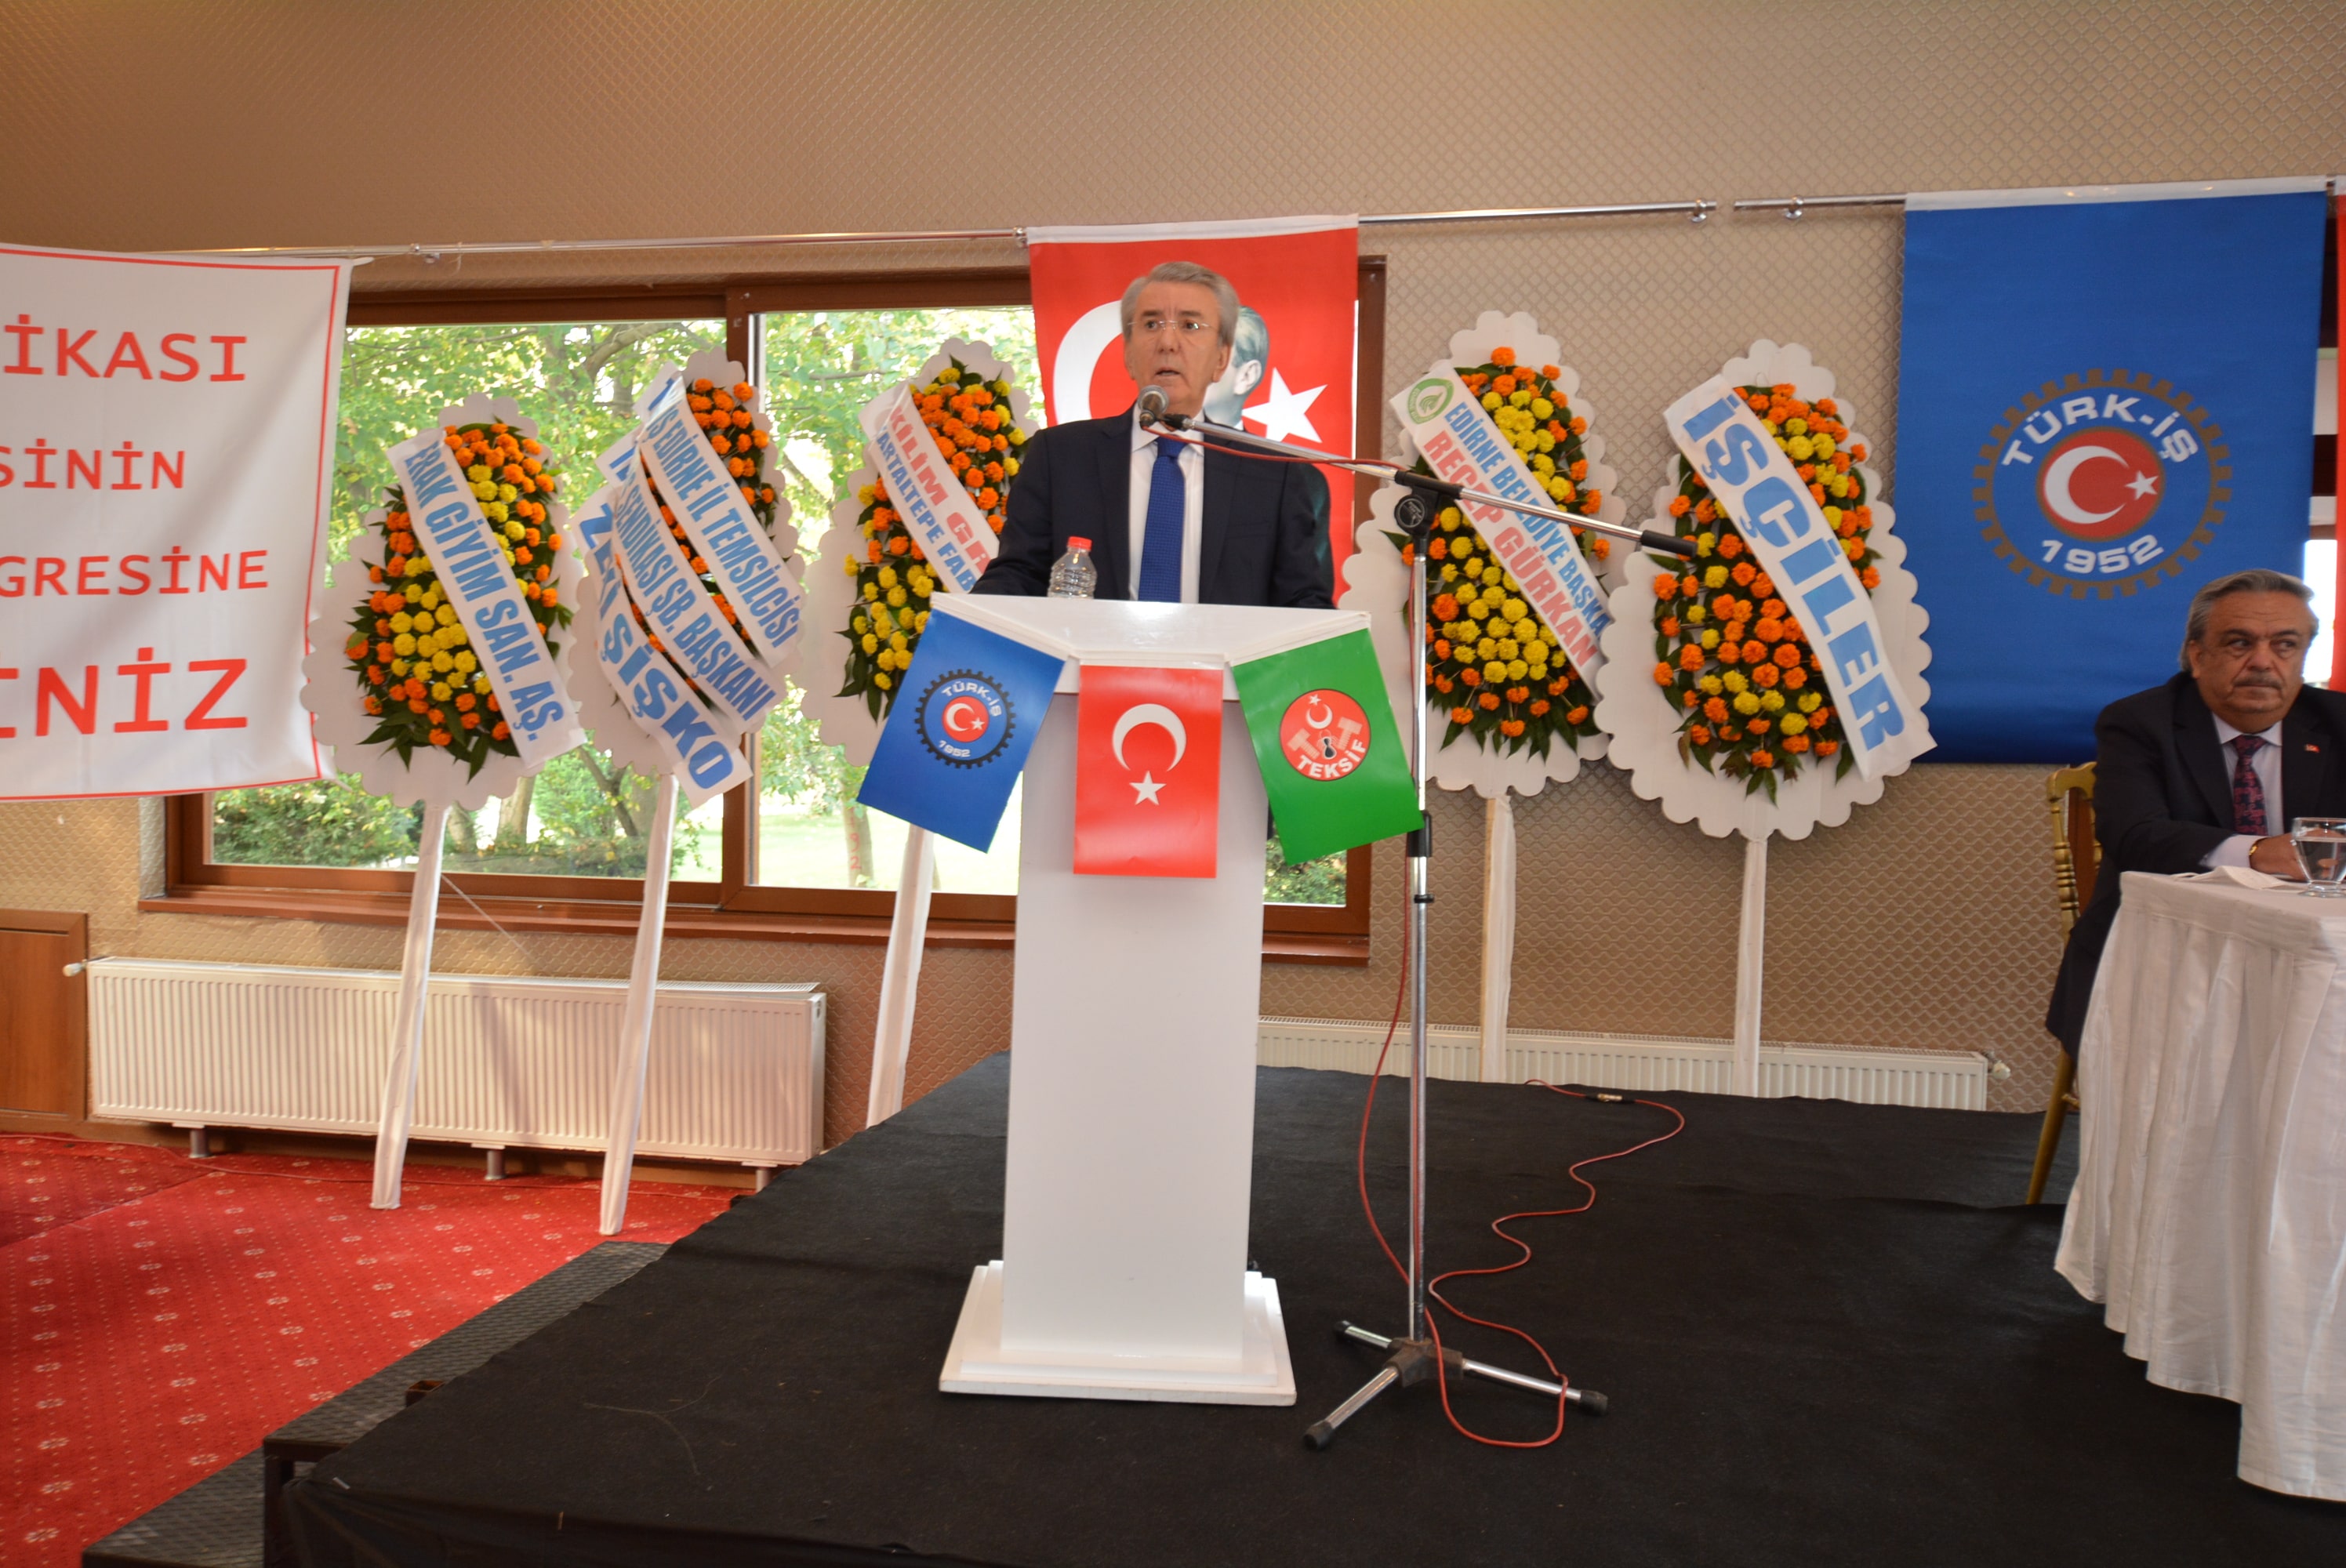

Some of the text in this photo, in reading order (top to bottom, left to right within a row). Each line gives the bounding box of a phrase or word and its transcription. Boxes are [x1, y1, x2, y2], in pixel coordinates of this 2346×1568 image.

[4, 314, 246, 382] İKASI
[652, 419, 717, 502] EDİRNE
[686, 482, 731, 523] İL
[890, 406, 949, 506] KİLİM
[2002, 394, 2199, 466] TÜRK-İŞ
[616, 484, 678, 597] SENDİKASI
[877, 428, 946, 544] ARTALTEPE
[1444, 401, 1506, 474] EDİRNE
[1559, 557, 1611, 637] BAŞKA
[646, 578, 696, 633] ŞB.
[1494, 527, 1598, 667] GÜRKAN
[1683, 394, 1905, 751] İŞÇİLER
[2042, 535, 2164, 574] 1952
[426, 500, 508, 602] GİYİM
[475, 599, 540, 683] SAN.
[510, 681, 564, 741] AŞ.
[673, 612, 776, 721] BAŞKANI
[600, 613, 734, 789] ŞİŞKO
[1298, 739, 1367, 778] TEKSİF
